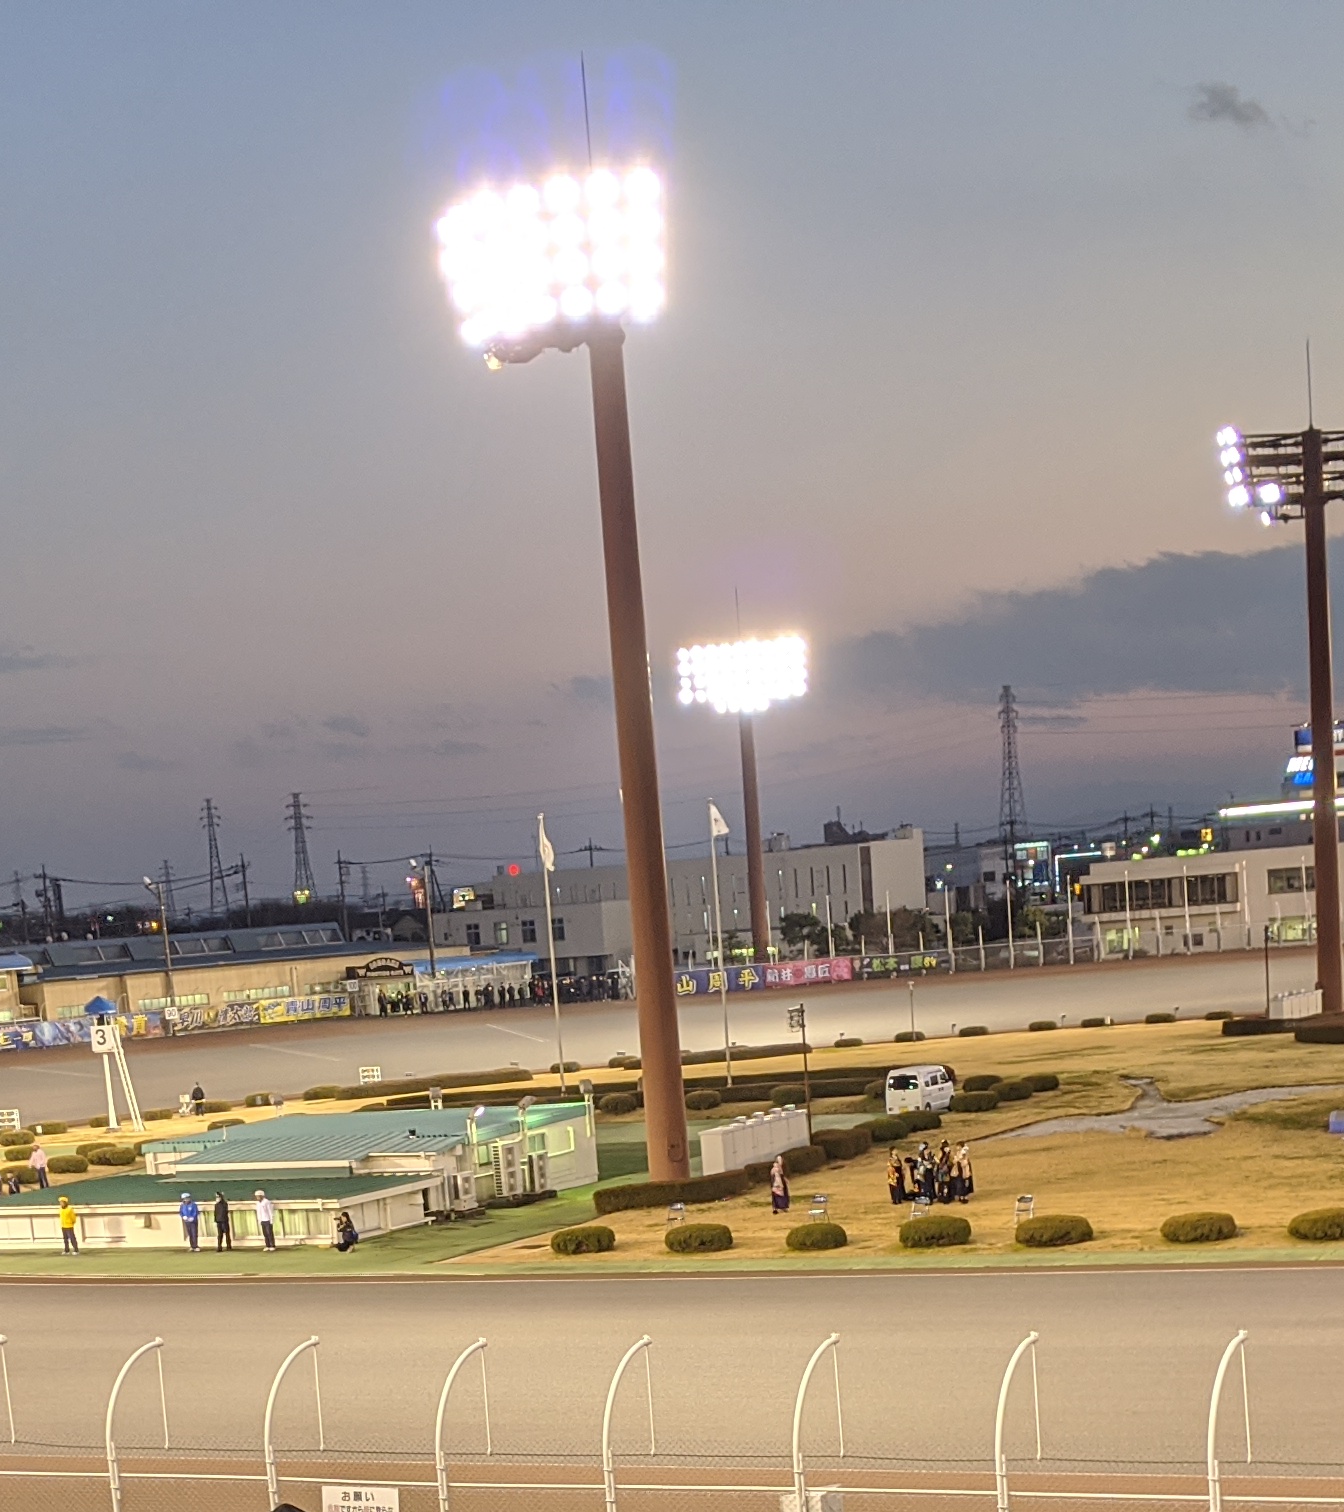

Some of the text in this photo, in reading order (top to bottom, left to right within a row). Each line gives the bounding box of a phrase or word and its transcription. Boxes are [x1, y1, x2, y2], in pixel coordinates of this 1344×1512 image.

[166, 1009, 177, 1018] 90
[96, 1029, 107, 1046] 3
[341, 1491, 375, 1502] お願い
